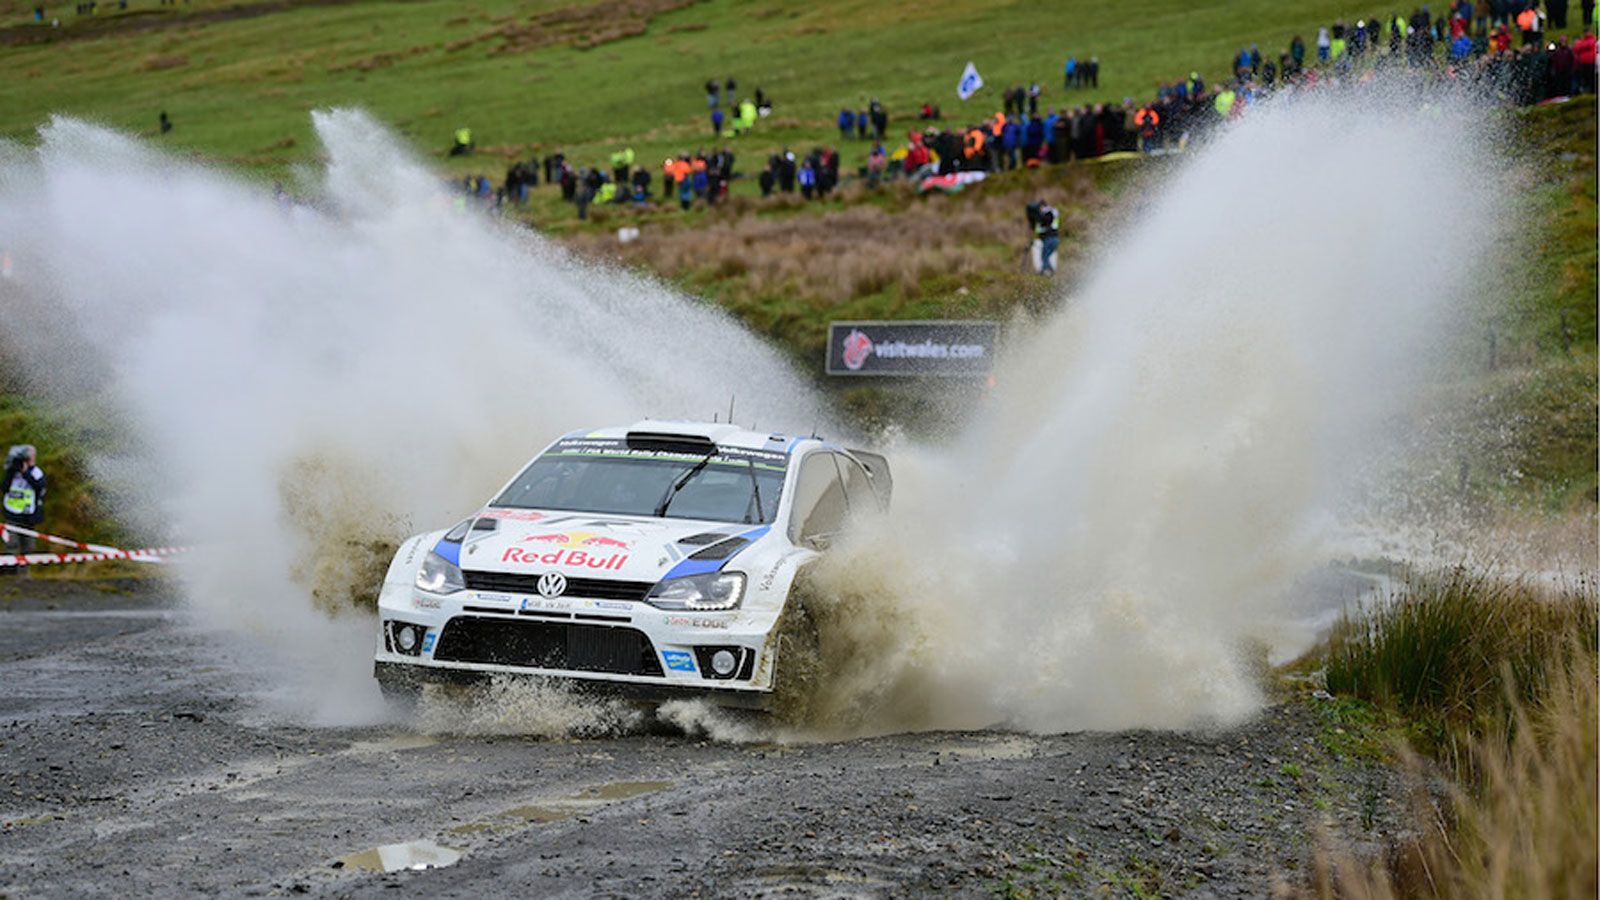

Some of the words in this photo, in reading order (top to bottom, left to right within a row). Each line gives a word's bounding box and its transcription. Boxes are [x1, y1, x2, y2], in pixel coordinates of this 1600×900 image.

[875, 339, 984, 358] visitwales.com
[603, 448, 629, 456] World
[631, 449, 655, 458] Rally
[656, 450, 723, 462] Championhip
[716, 446, 786, 460] Volkswagen
[501, 547, 565, 565] Red
[564, 550, 629, 570] Bull
[692, 618, 728, 629] EDGE
